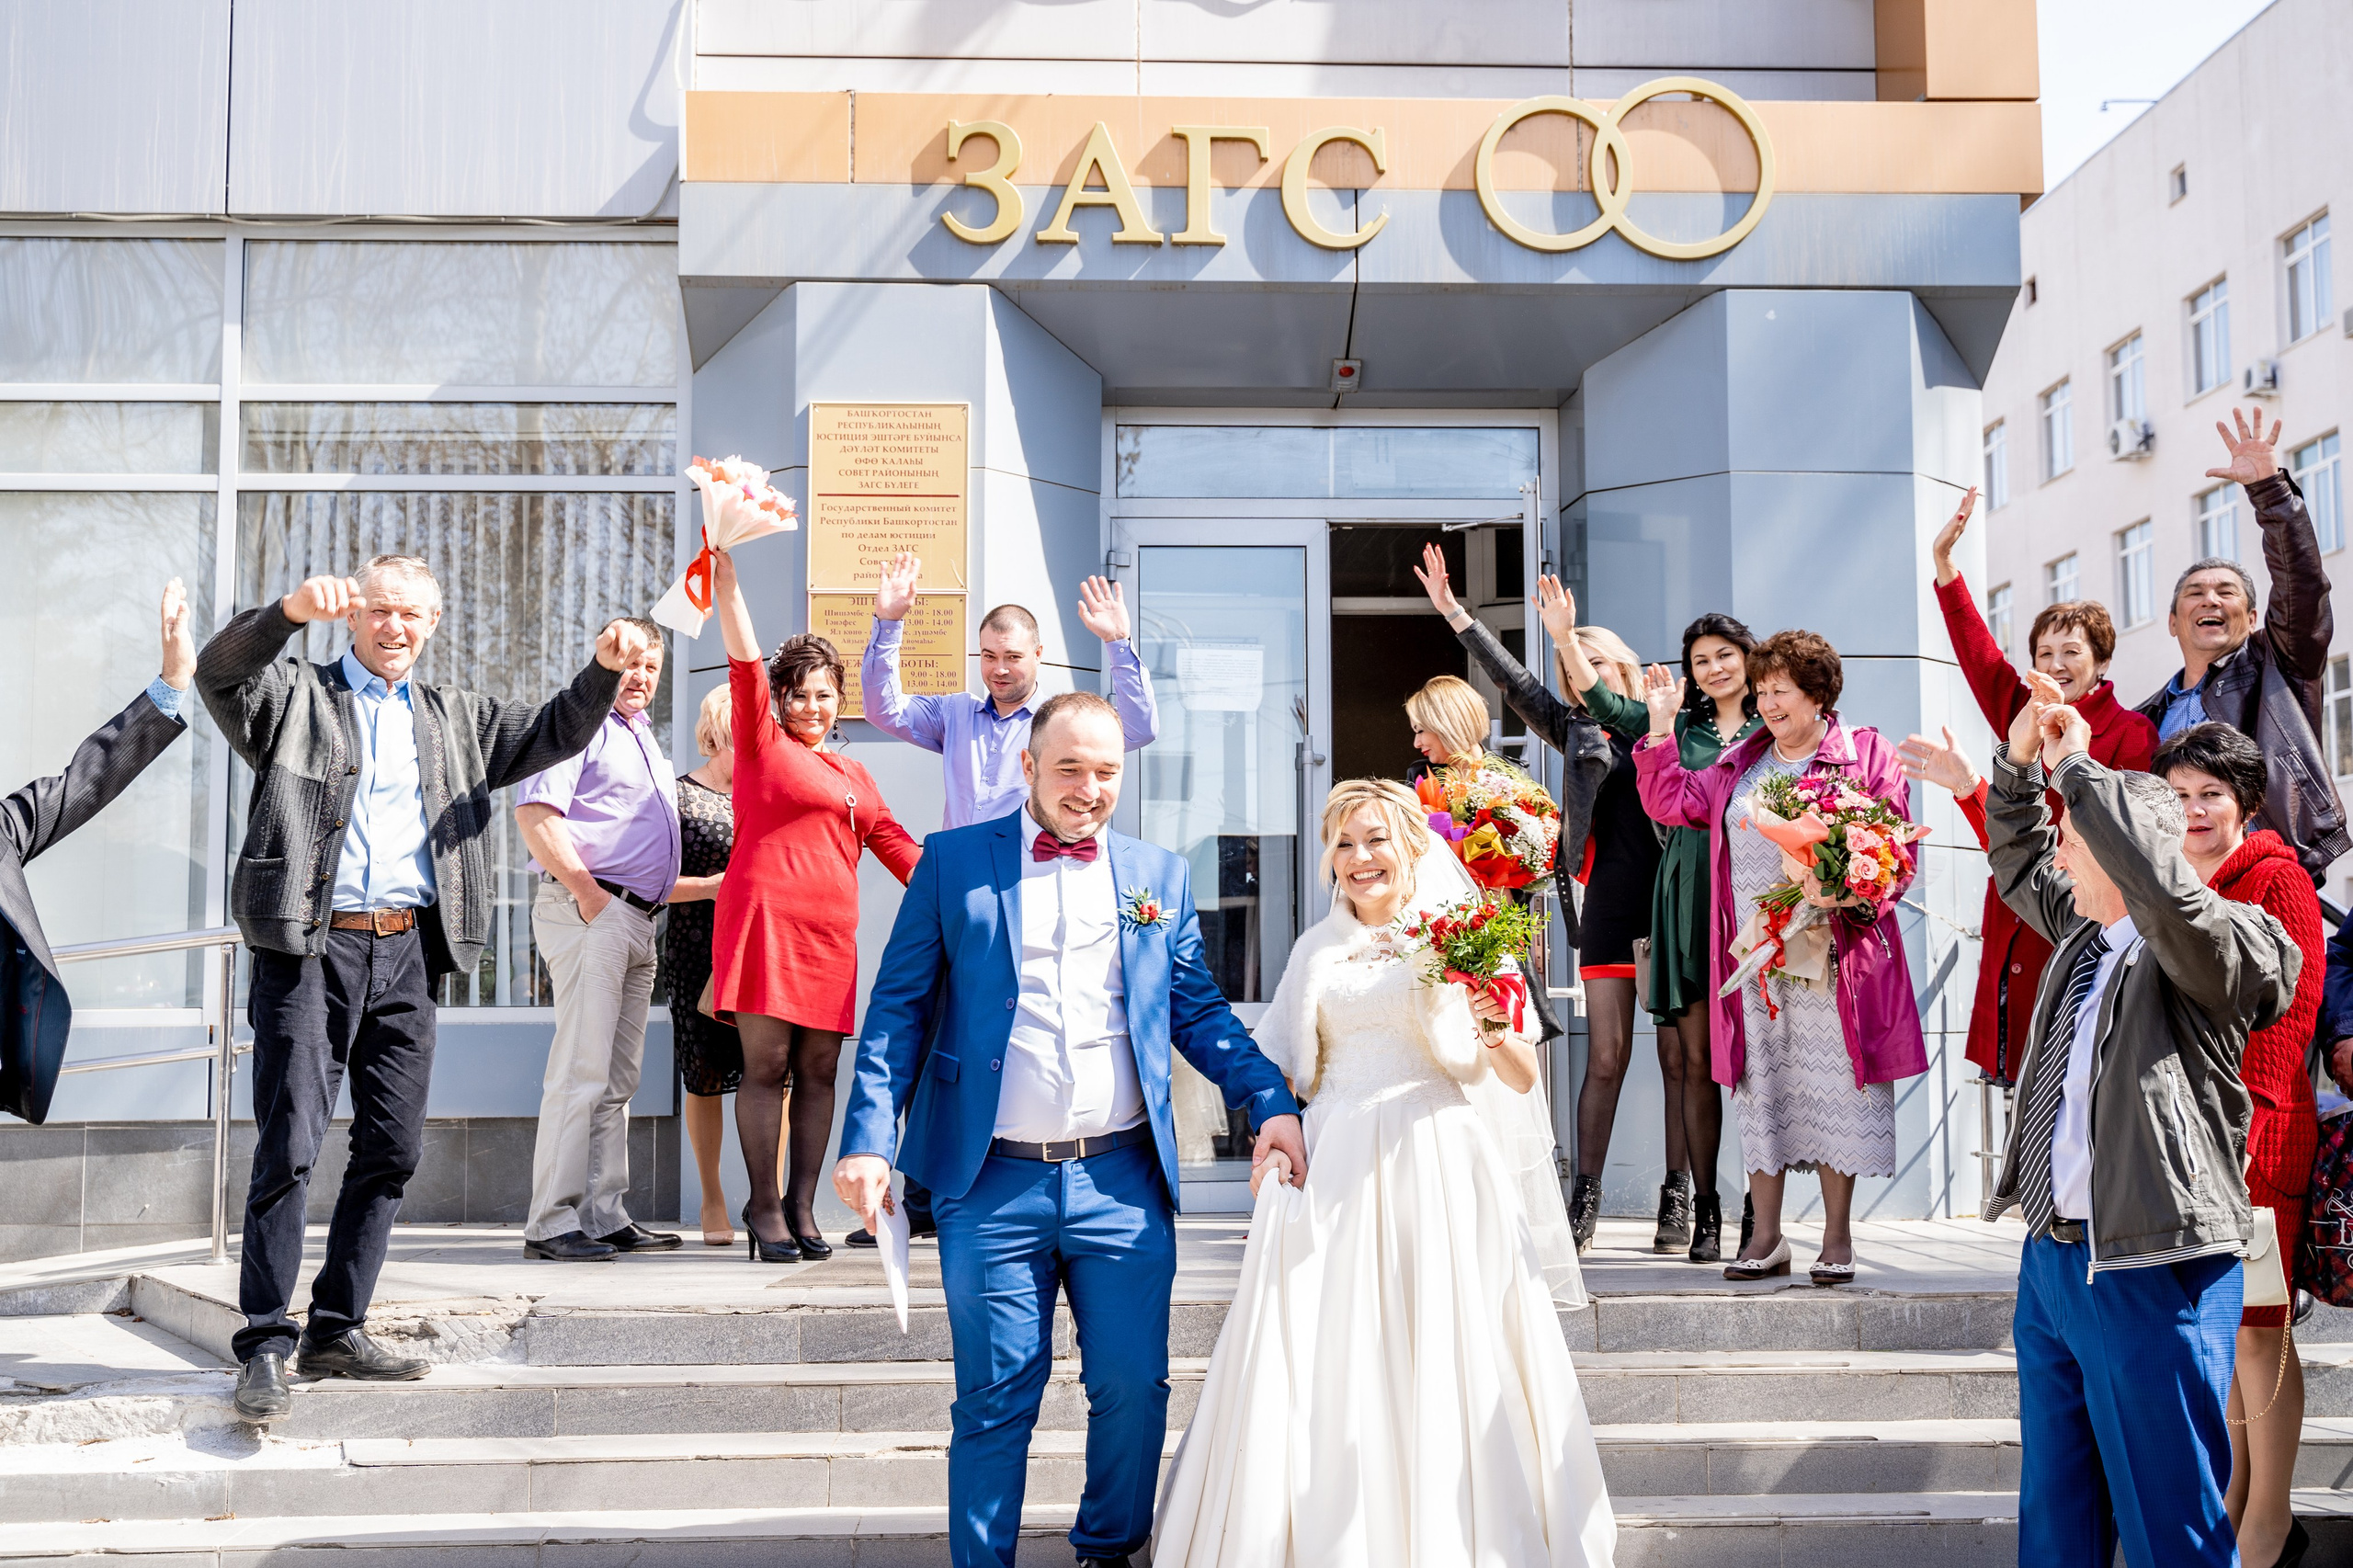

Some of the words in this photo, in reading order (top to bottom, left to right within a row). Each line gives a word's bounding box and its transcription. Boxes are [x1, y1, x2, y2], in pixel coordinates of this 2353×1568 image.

[941, 119, 1390, 250] ЗАГС
[816, 434, 869, 442] ЮСТИЦИЯ
[914, 433, 962, 442] БУЙЫНСА
[882, 446, 939, 454] КОМИТЕТЫ
[821, 503, 911, 514] Государственный
[820, 517, 881, 528] Республики
[883, 517, 958, 528] Башкортостан
[857, 532, 887, 540] делам
[890, 532, 936, 540] юстиции
[858, 544, 889, 553] Отдел
[892, 544, 919, 552] ЗАГС
[847, 597, 868, 606] ЭШ
[901, 659, 938, 668] БОТЫ:
